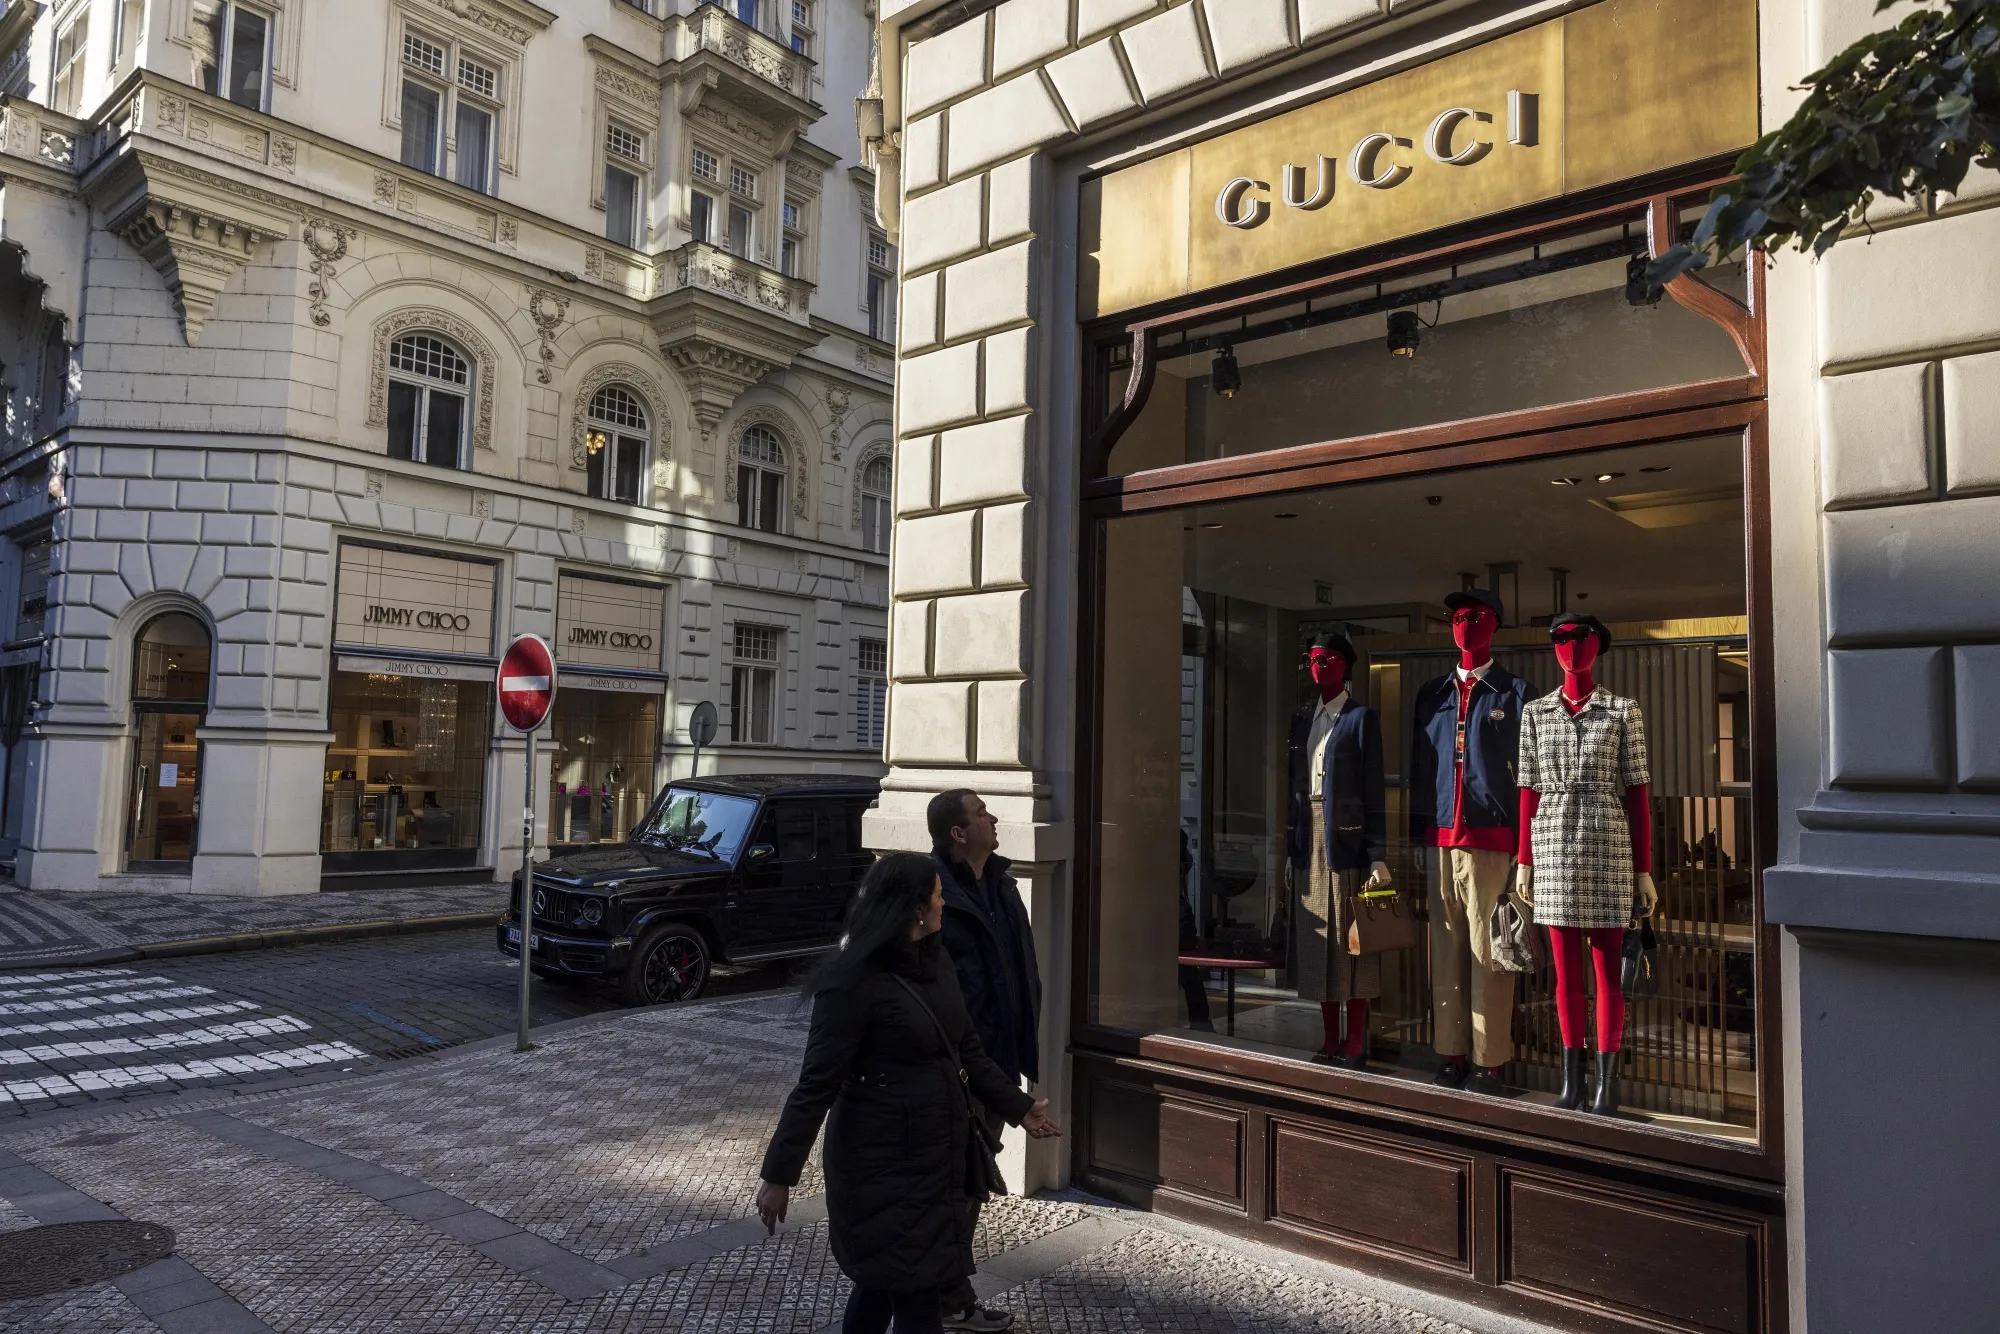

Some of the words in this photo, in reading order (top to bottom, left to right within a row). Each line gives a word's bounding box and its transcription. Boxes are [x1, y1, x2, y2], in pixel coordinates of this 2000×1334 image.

[1214, 89, 1539, 230] GUCCI
[363, 605, 415, 627] JIMMY
[416, 610, 470, 631] CHOO
[568, 627, 608, 645] JIMMY
[609, 631, 653, 650] CHOO
[385, 661, 415, 674] JIMMY
[416, 664, 449, 676] CHOO
[588, 678, 612, 689] JIMMY
[612, 679, 638, 690] CHOO
